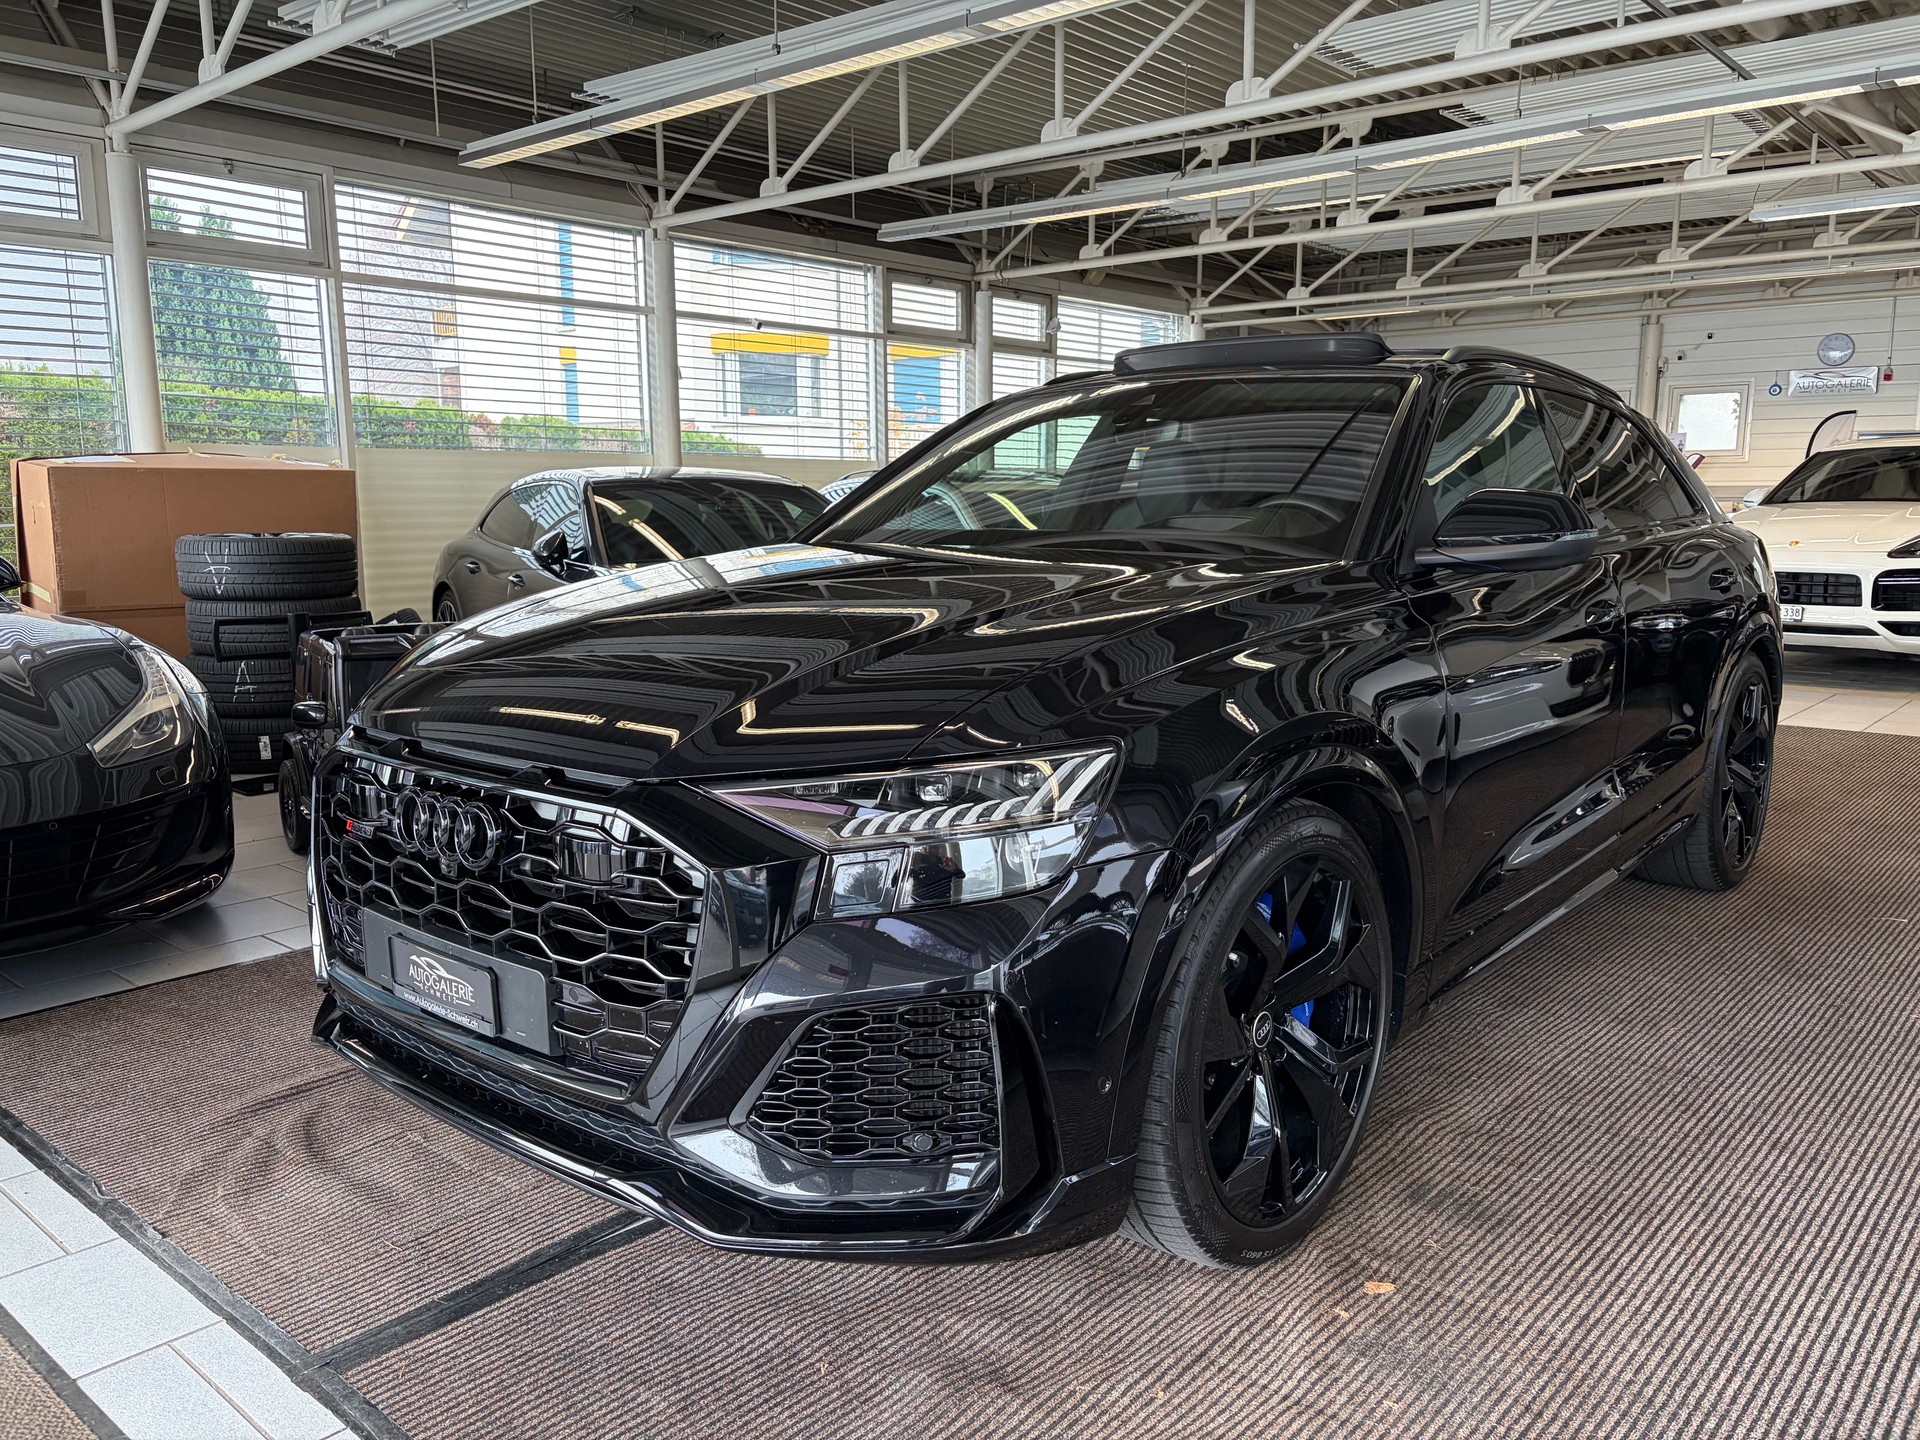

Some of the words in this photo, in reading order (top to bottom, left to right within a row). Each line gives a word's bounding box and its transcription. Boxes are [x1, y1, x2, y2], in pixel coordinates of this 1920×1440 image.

[1794, 378, 1872, 390] AUTOGALERIE
[1783, 607, 1800, 617] 338
[409, 964, 475, 1003] AUTOGALERIE
